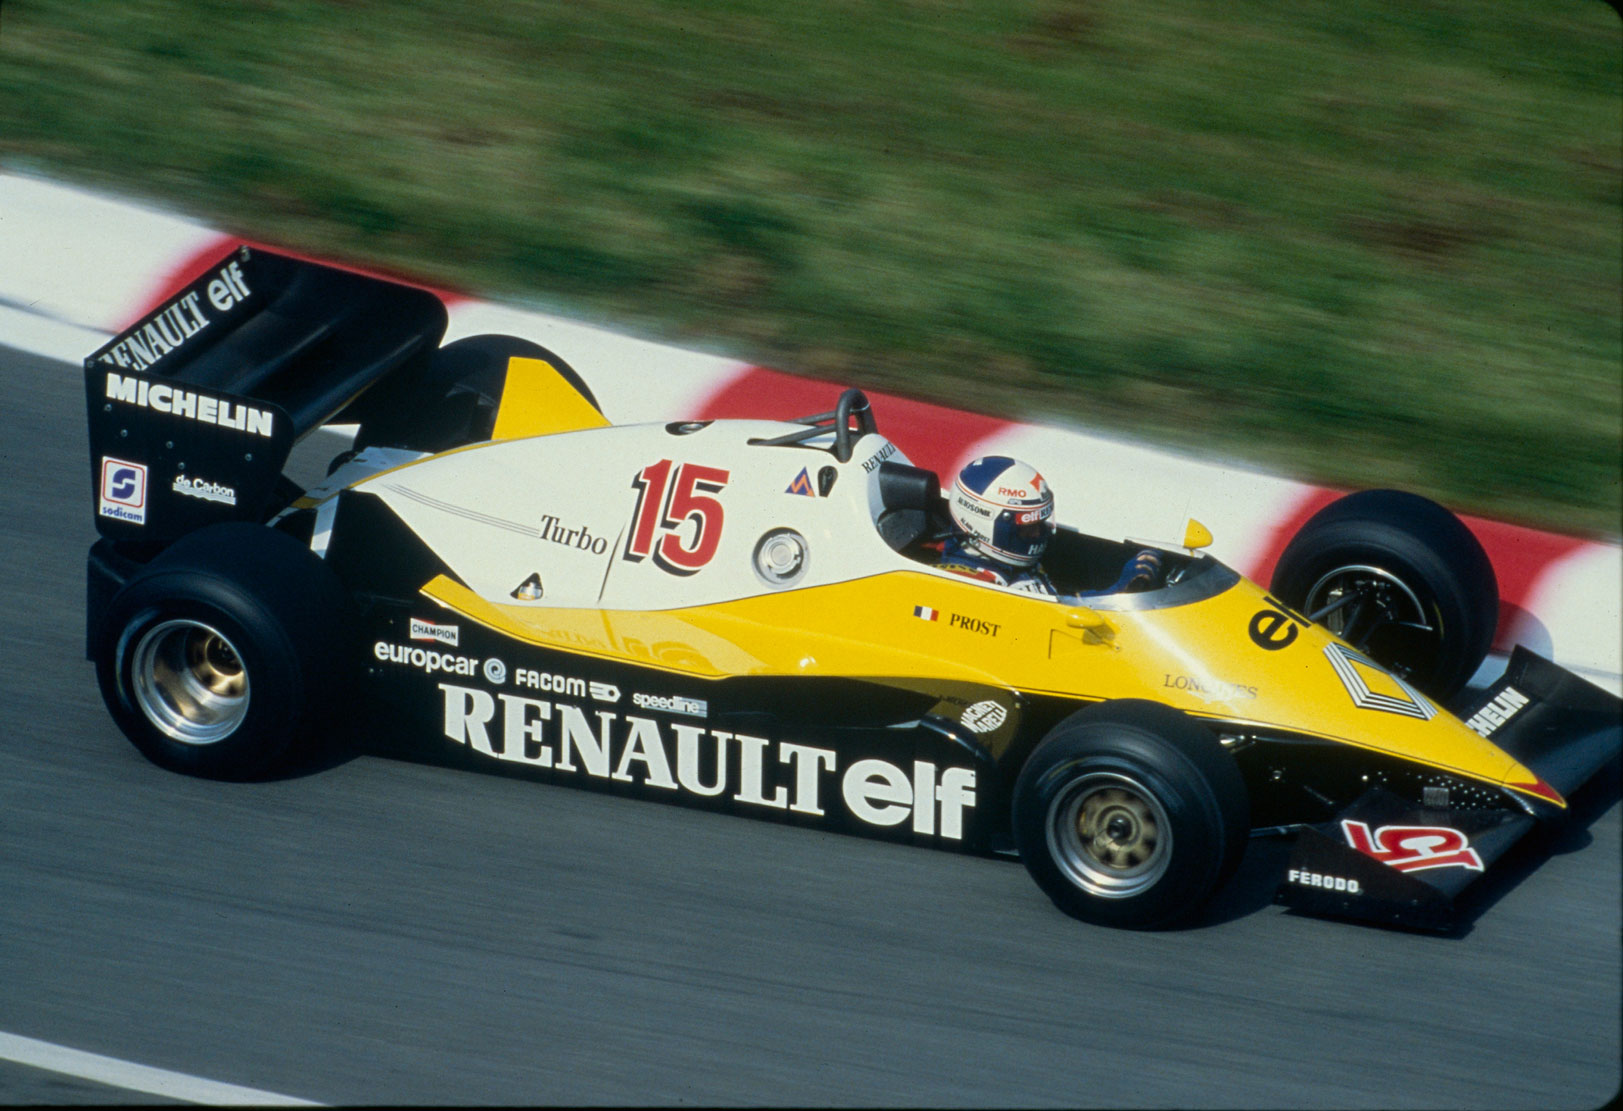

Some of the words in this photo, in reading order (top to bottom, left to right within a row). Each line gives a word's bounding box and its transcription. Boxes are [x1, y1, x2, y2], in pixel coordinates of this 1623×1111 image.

[207, 261, 250, 311] elf
[106, 372, 273, 438] MICHELIN
[175, 474, 191, 488] de
[193, 478, 235, 498] Carbon
[998, 487, 1027, 498] RMO
[103, 506, 143, 522] sodicam
[622, 459, 731, 577] 15
[1021, 511, 1040, 523] elf
[539, 514, 608, 555] Turbo
[412, 624, 457, 640] CHAMPION
[949, 613, 1002, 637] PROST
[374, 641, 479, 676] europcar
[515, 669, 586, 698] FACOM
[633, 692, 700, 713] speedline
[1464, 686, 1530, 738] HELIN
[438, 683, 837, 816] RENAULT
[842, 758, 977, 840] elf
[1341, 818, 1485, 873] 15
[1288, 869, 1360, 893] FERODO
